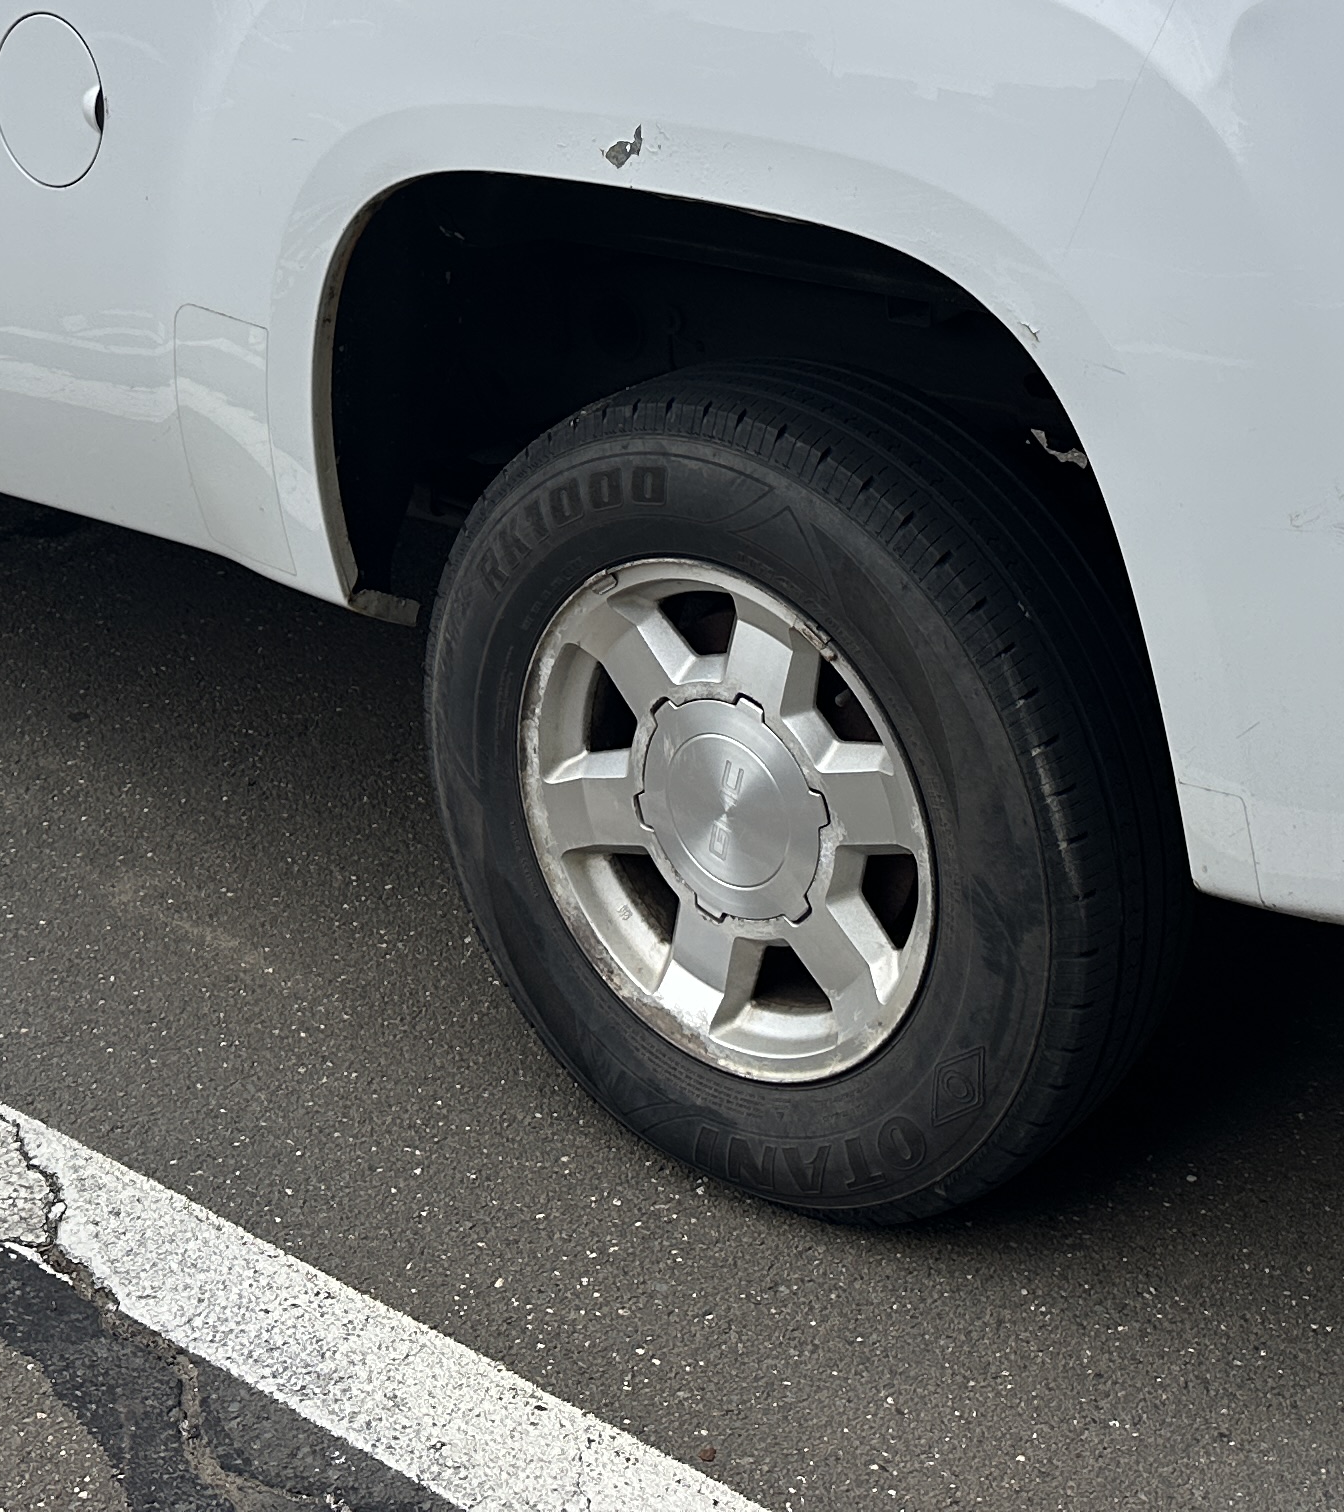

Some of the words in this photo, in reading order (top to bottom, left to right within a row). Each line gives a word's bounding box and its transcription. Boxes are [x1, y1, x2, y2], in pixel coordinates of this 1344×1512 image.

[476, 465, 670, 600] RK1000
[708, 759, 744, 862] GMC
[694, 1114, 927, 1196] OTANI
